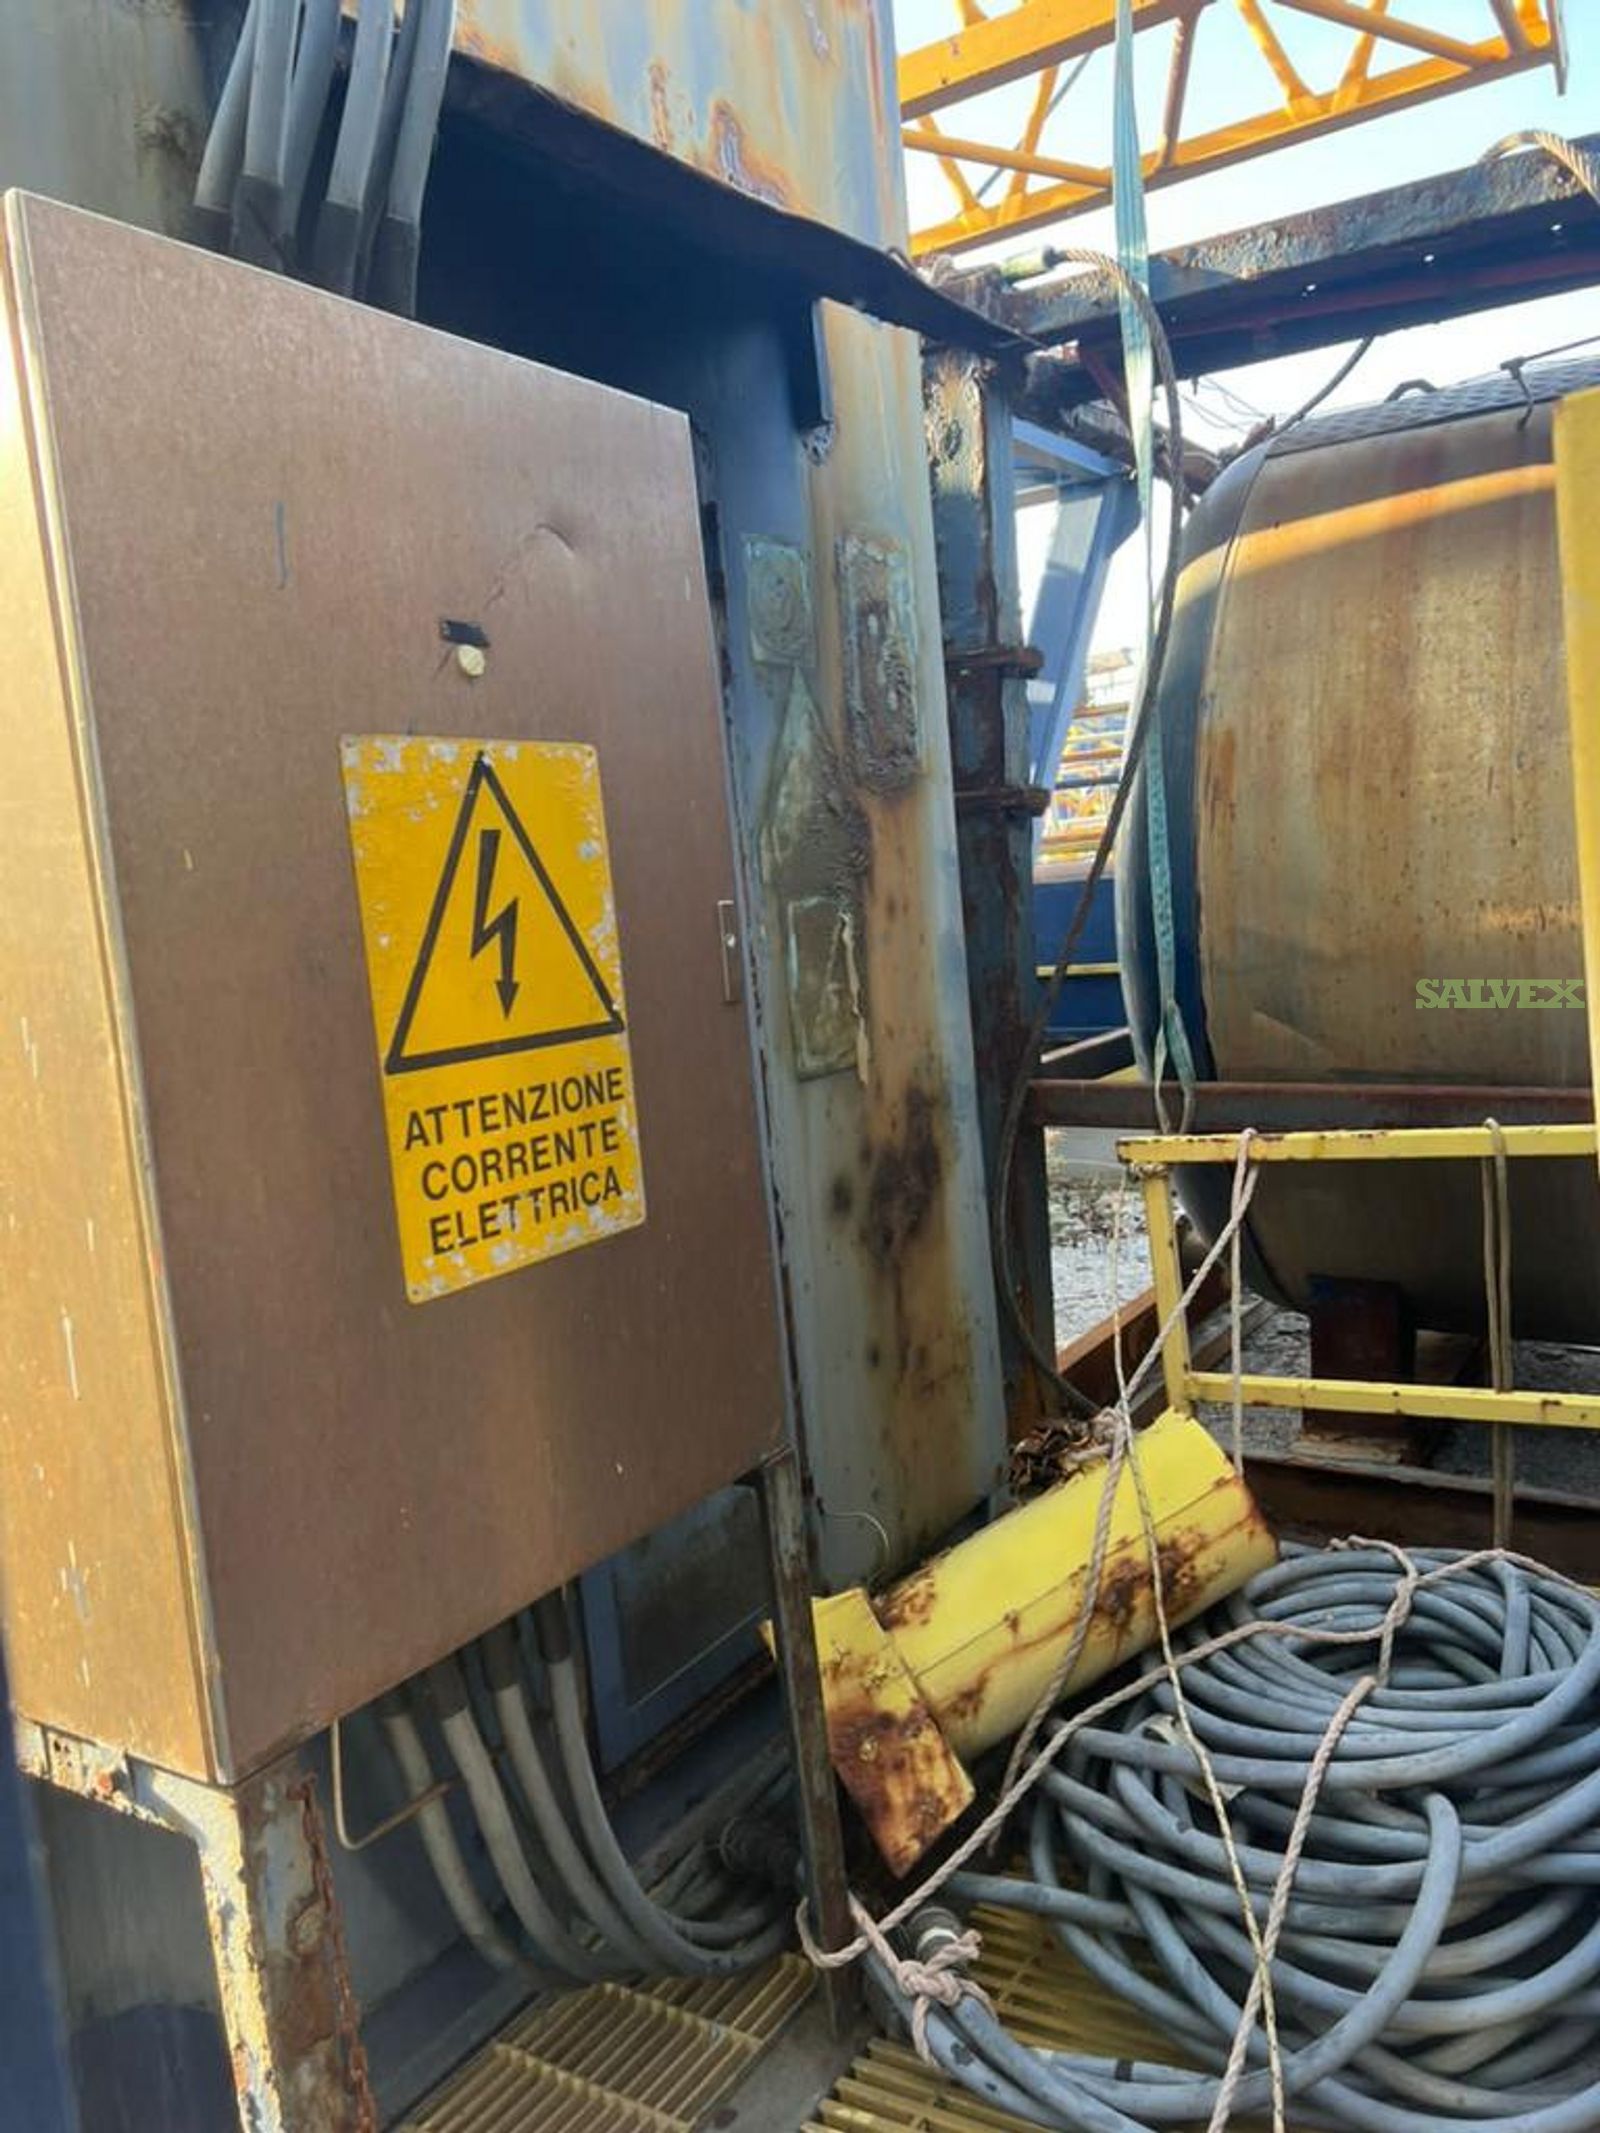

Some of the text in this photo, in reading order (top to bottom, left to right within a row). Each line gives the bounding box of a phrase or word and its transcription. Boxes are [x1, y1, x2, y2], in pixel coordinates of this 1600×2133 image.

[404, 1067, 625, 1151] ATTENZIONE
[421, 1117, 620, 1201] CORRENTE
[430, 1166, 623, 1255] ELETTRICA
